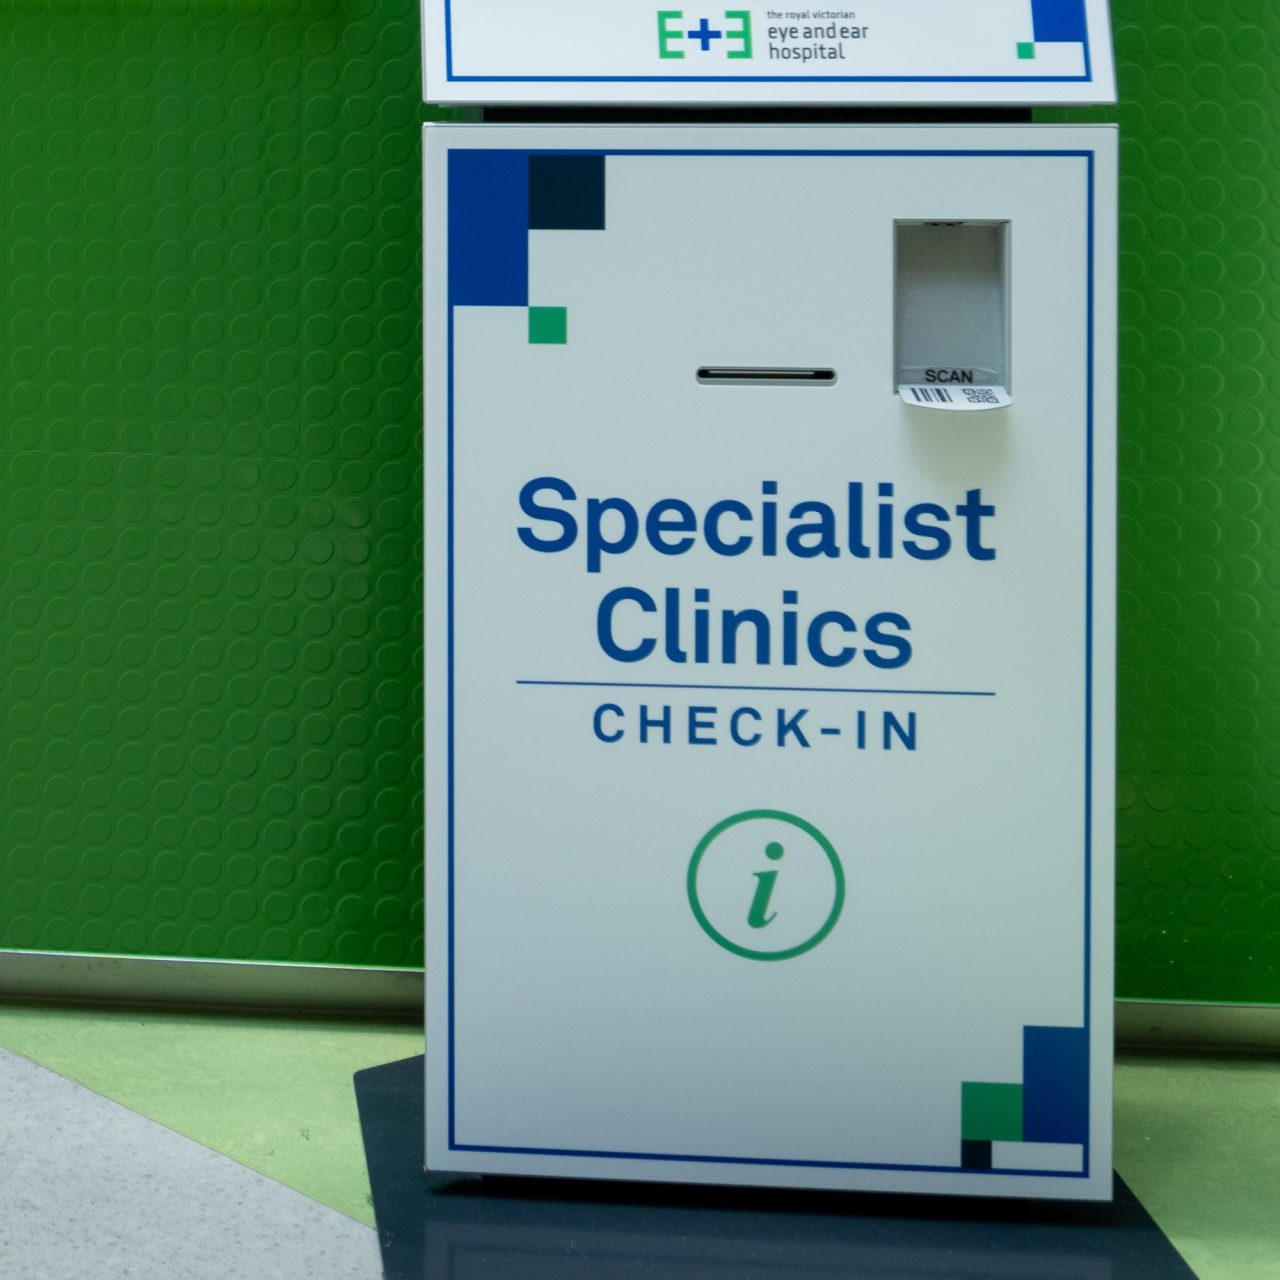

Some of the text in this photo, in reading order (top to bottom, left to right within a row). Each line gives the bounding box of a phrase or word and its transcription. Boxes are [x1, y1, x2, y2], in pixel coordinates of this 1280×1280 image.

[767, 10, 856, 20] the royal victorian
[768, 23, 869, 42] eye and ear
[769, 42, 845, 63] hospital
[925, 369, 974, 384] SCAN
[516, 476, 997, 573] Specialist
[596, 586, 913, 669] Clinics
[592, 703, 919, 751] CHECK-IN
